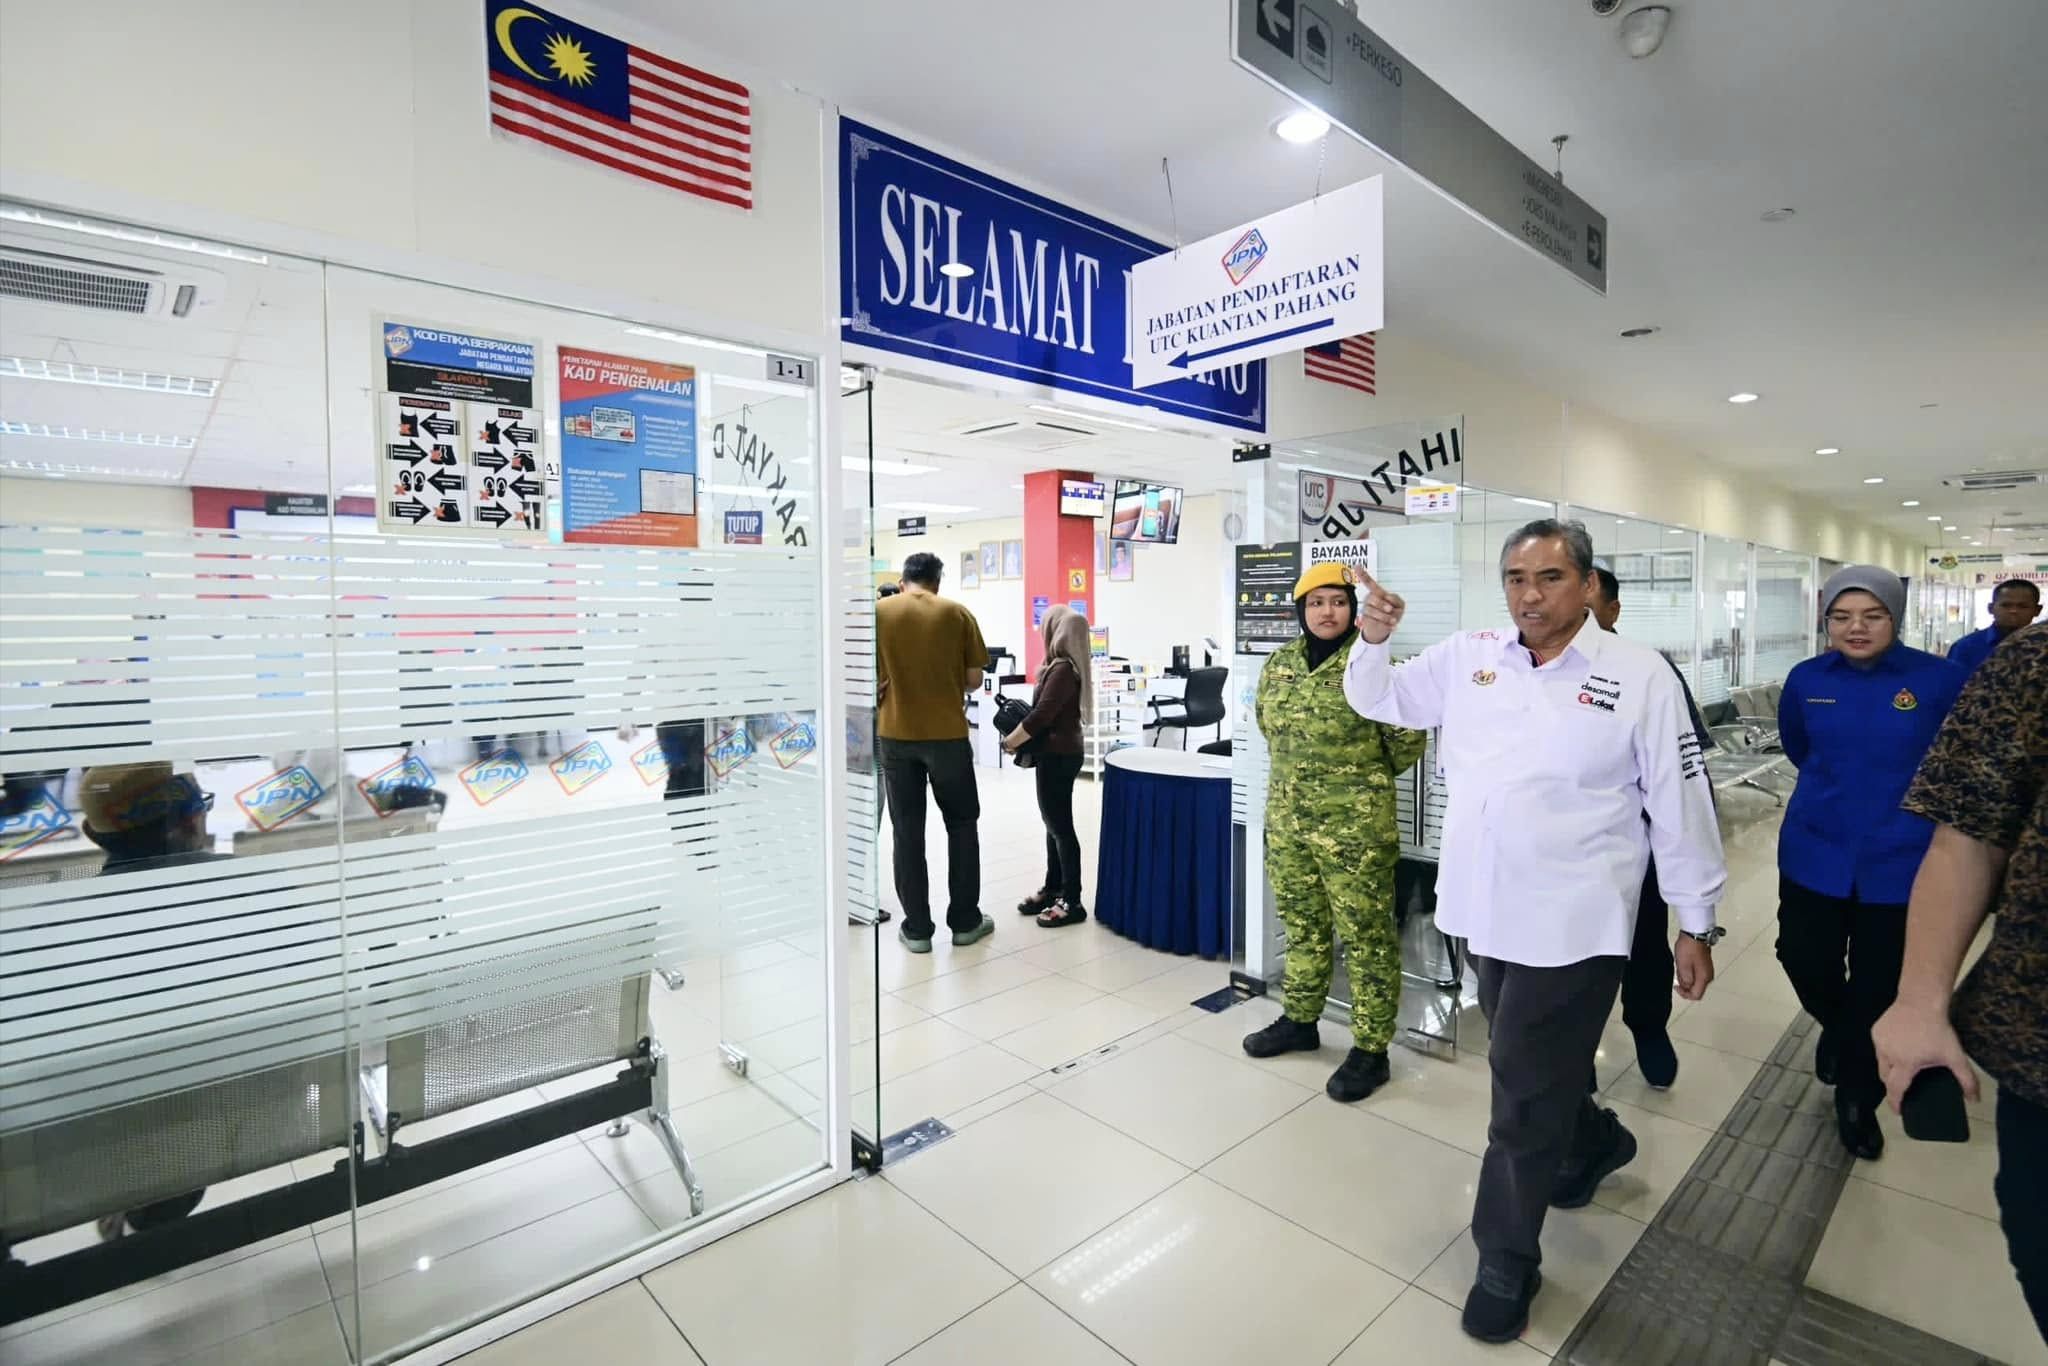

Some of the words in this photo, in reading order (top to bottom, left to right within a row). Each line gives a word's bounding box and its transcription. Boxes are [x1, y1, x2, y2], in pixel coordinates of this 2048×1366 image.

[1352, 31, 1402, 87] PERKESO
[1226, 240, 1264, 267] JPN
[879, 183, 1101, 355] SELAMAT
[1146, 299, 1216, 337] JABATAN
[1222, 254, 1361, 319] PENDAFTARAN
[1149, 330, 1183, 356] UTC
[1186, 310, 1268, 346] KUANTAN
[1274, 282, 1356, 325] PAHANG
[413, 329, 437, 342] KOD
[439, 334, 470, 347] ETIKA
[470, 338, 534, 356] BERPAKAIAN
[775, 361, 806, 379] 1-1
[564, 364, 596, 381] KAD
[599, 370, 692, 396] PENGENALAN
[1304, 481, 1325, 499] UTC
[727, 515, 760, 533] TUTUP
[1311, 544, 1369, 559] BAYARAN
[1581, 682, 1621, 700] desamall
[712, 744, 752, 760] JPN
[776, 737, 815, 752] JPN
[556, 756, 609, 774] JPN
[467, 766, 524, 784] JPN
[246, 782, 318, 807] JPN
